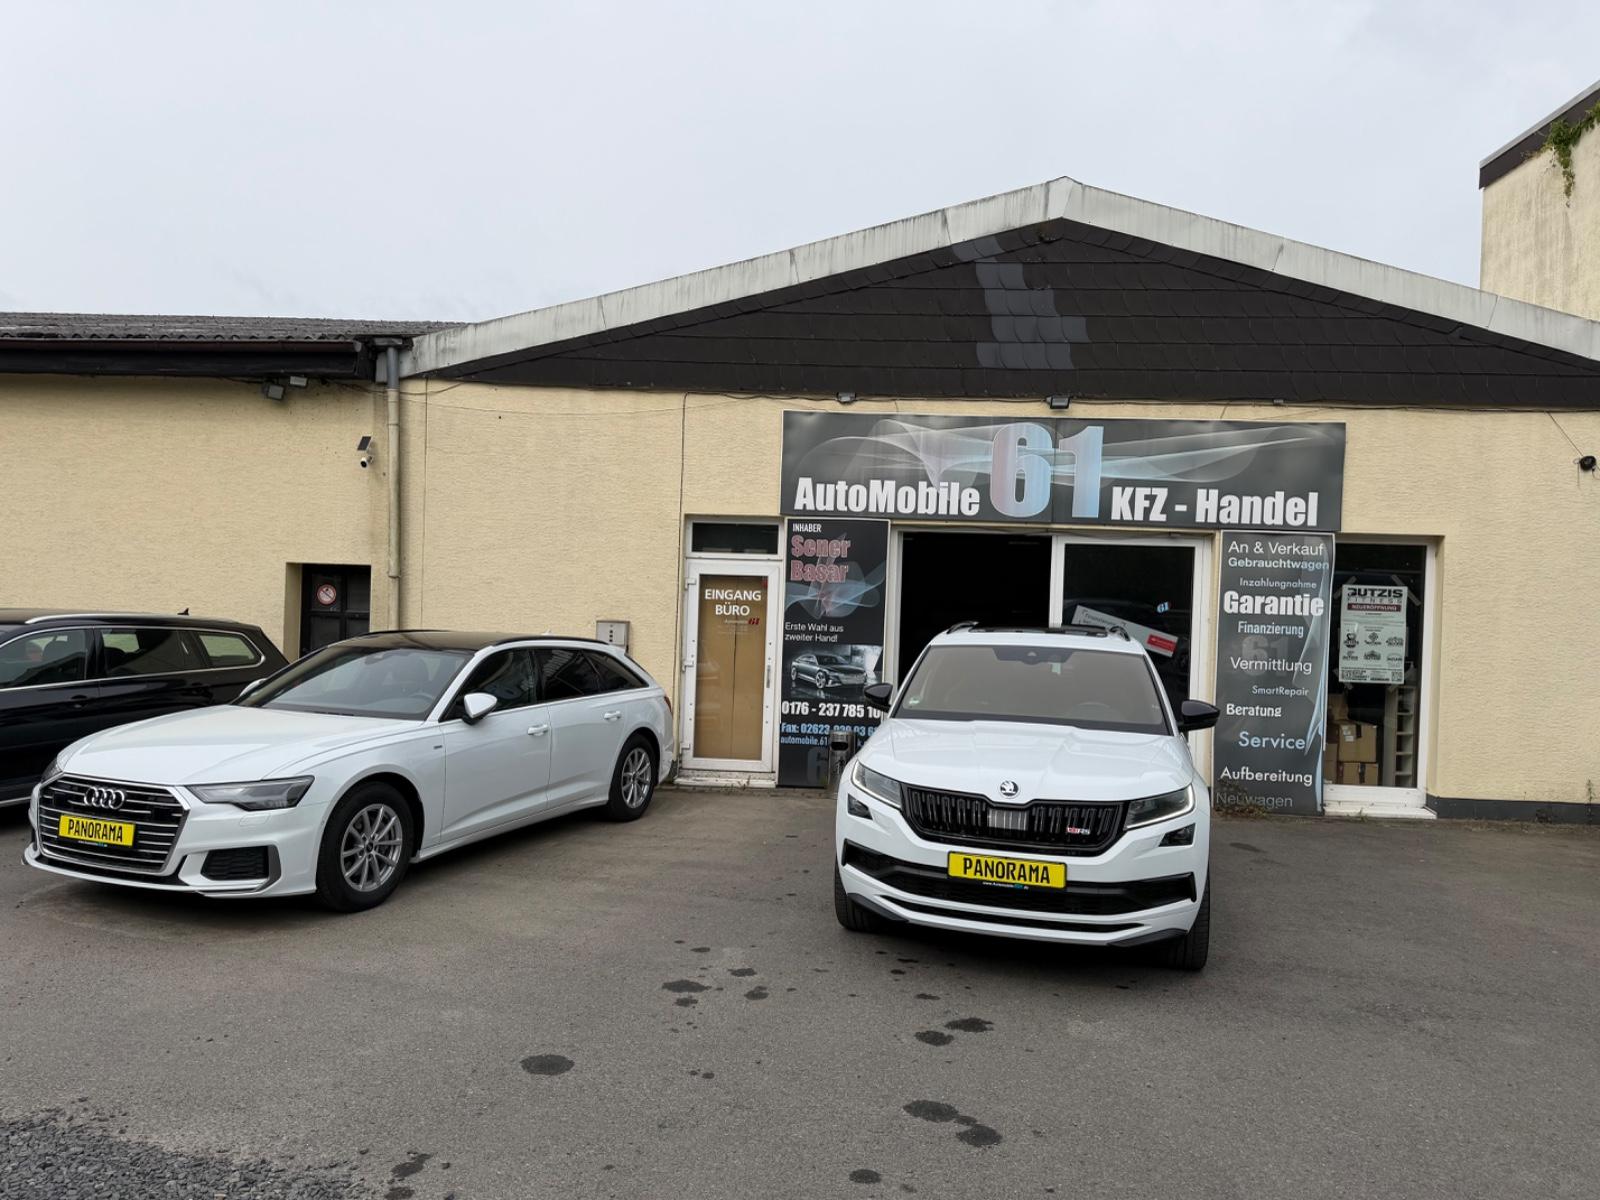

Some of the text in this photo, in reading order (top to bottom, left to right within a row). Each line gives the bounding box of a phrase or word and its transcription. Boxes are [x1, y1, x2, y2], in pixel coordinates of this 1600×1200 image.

[794, 422, 1319, 527] AutoMobile 61 KFZ - Handel
[792, 523, 822, 533] INHABER
[791, 534, 851, 558] Sener
[1228, 541, 1324, 556] An & Verkauf
[1228, 557, 1329, 571] Gebrauchtwagen
[790, 560, 849, 584] Basar
[1240, 578, 1317, 590] Inzahlungnahme
[704, 588, 762, 602] EINGANG
[715, 603, 750, 616] BÜRO
[1223, 590, 1324, 617] Garantie
[785, 622, 844, 633] Erste Wahl aus
[1238, 620, 1304, 638] Finanzierung
[784, 633, 838, 643] zweiter Hand!
[1230, 656, 1312, 675] Vermittlung
[1252, 685, 1310, 698] SmartRepair
[781, 700, 810, 715] 0176
[818, 703, 841, 717] 237
[842, 704, 864, 718] 785
[1226, 703, 1282, 717] Beratung
[781, 722, 799, 733] Fax:
[801, 723, 830, 735] 02623
[780, 735, 829, 746] automobile.61
[1238, 731, 1306, 749] Service
[1219, 766, 1313, 788] Aufbereitung
[68, 818, 123, 843] PANORAMA
[963, 857, 1051, 884] PANORAMA
